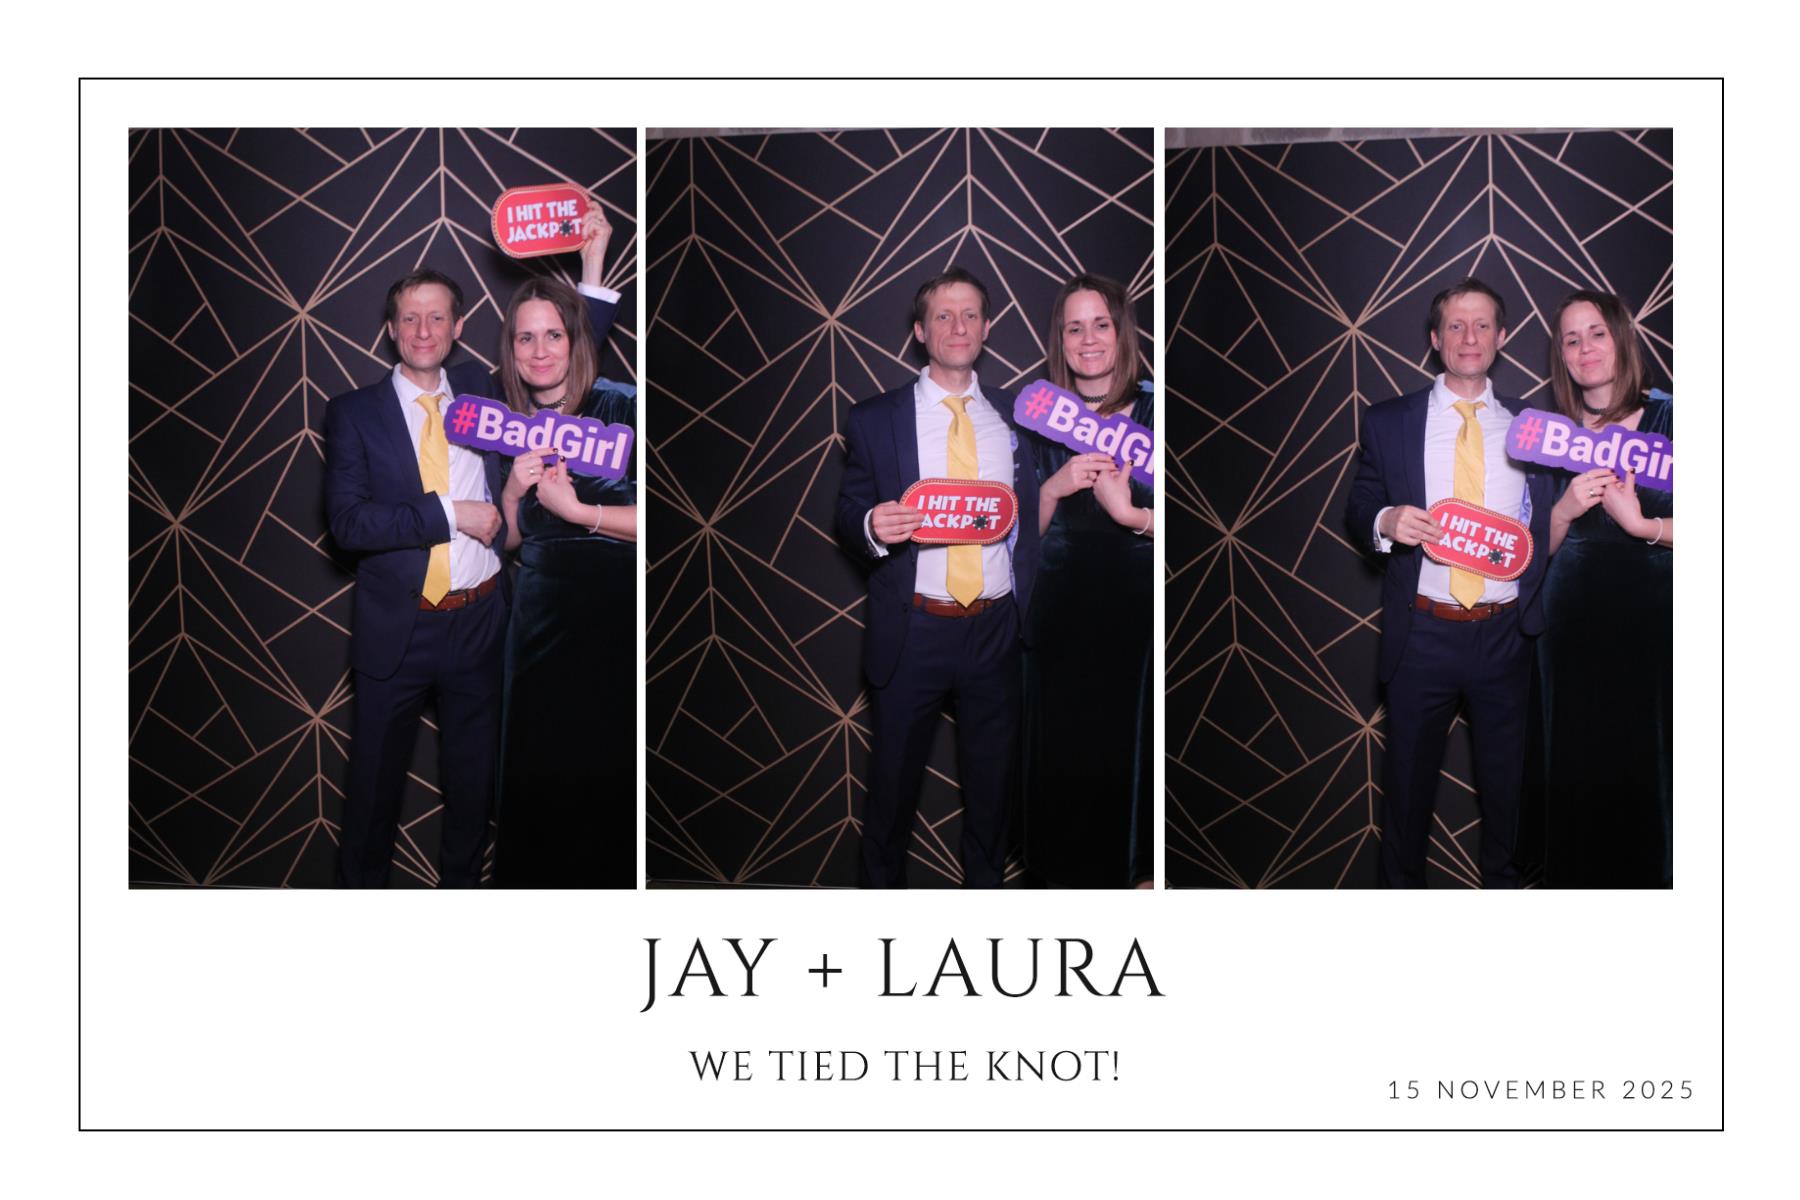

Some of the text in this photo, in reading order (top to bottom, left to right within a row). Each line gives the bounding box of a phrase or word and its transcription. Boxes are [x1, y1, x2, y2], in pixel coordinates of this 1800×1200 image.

[507, 199, 577, 223] I HIT THE
[452, 402, 628, 471] #BadGirl
[1516, 415, 1673, 480] #BadGir
[917, 495, 1001, 512] I HIT THE
[921, 513, 1001, 530] ACKPOT
[1440, 512, 1518, 551] I HIT THE
[1439, 532, 1516, 568] ACKPOT
